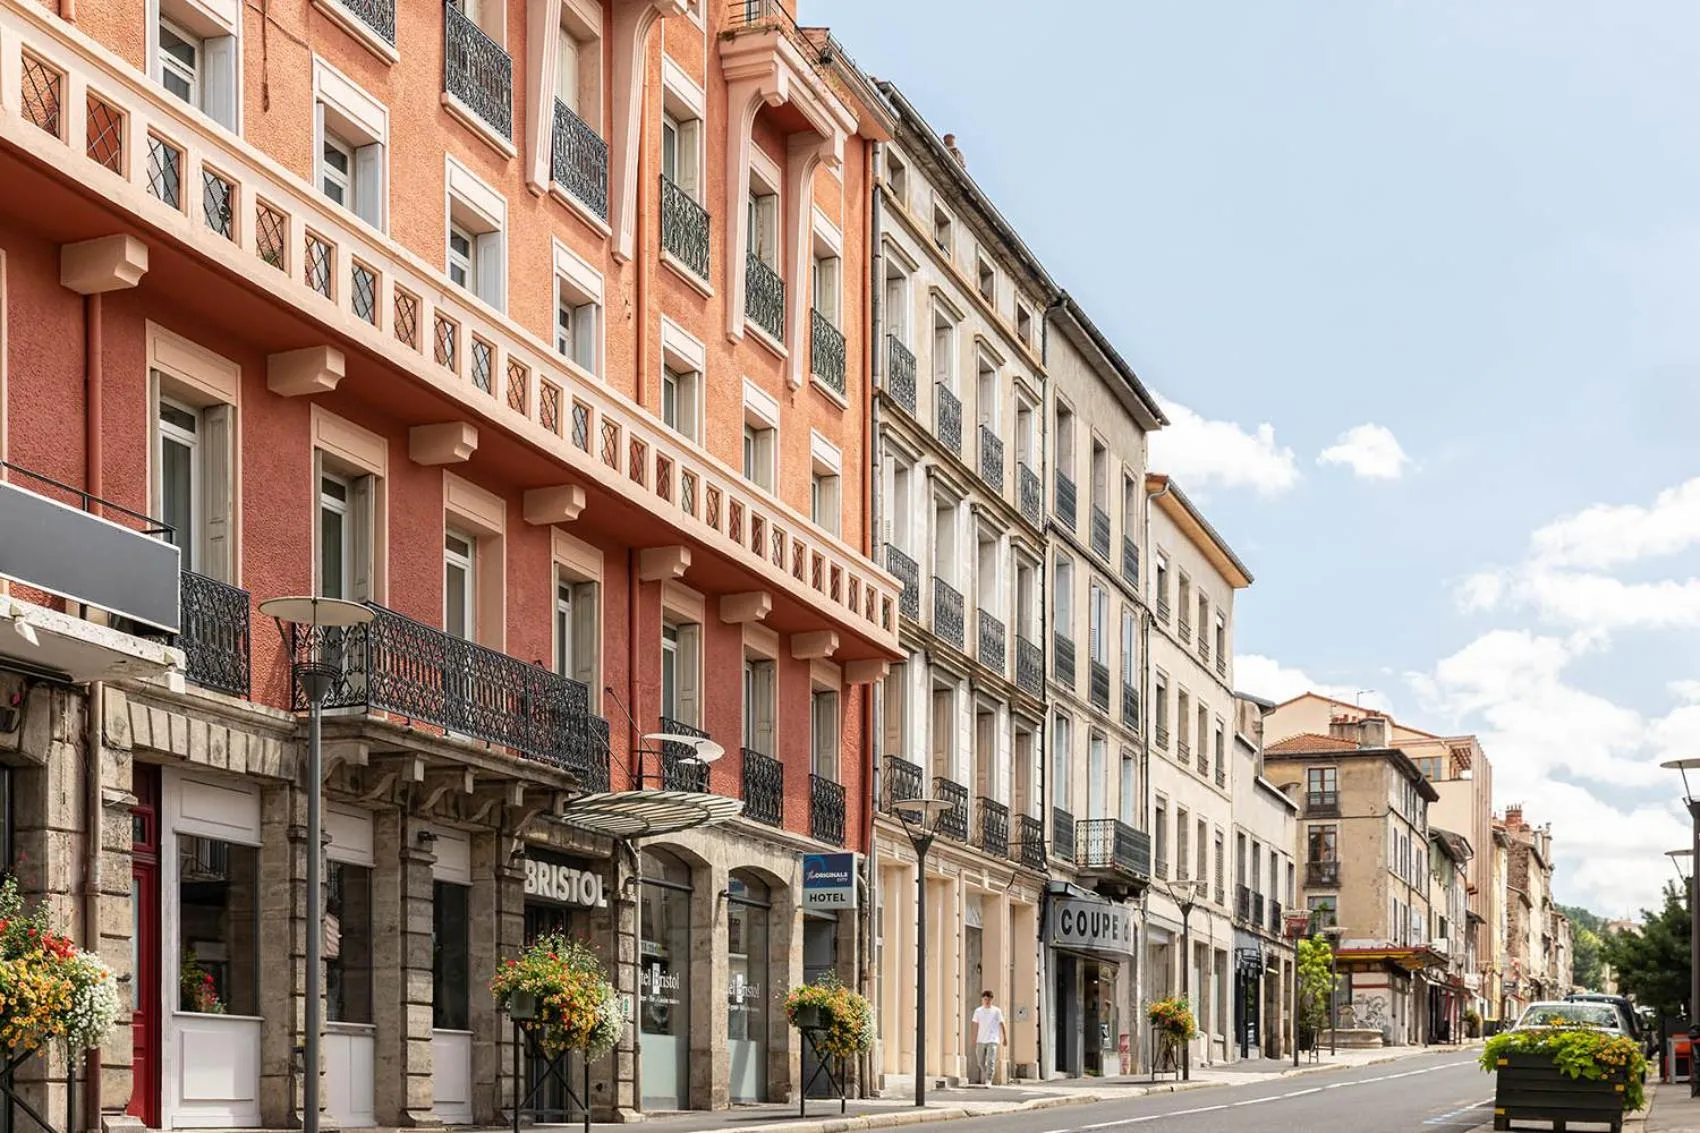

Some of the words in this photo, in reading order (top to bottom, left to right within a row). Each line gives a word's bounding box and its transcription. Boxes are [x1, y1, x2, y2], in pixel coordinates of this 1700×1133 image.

[524, 859, 608, 908] BRISTOL
[809, 893, 846, 902] HOTEL
[1061, 908, 1119, 940] COUPE
[653, 969, 680, 990] Bristol
